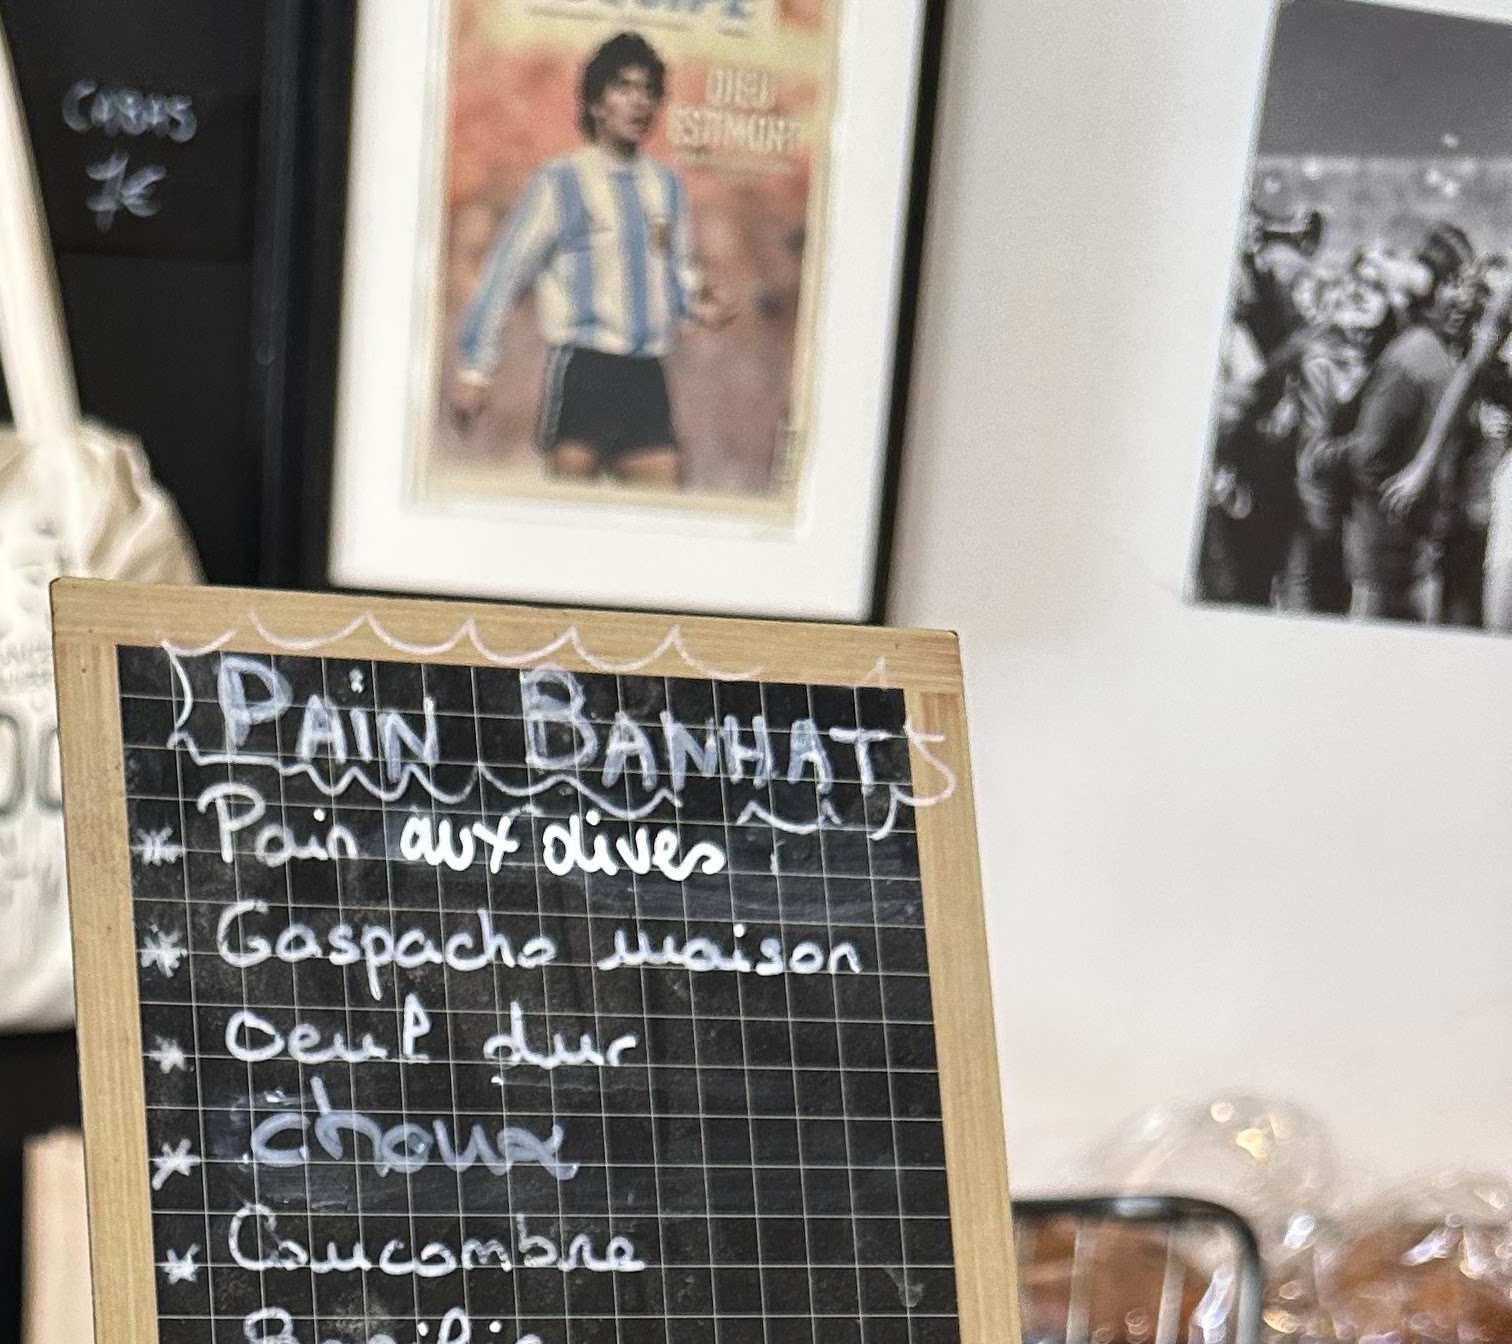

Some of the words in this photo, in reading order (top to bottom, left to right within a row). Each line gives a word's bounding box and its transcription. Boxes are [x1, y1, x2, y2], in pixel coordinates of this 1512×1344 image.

[196, 783, 359, 868] Pain
[399, 814, 522, 875] aux
[216, 898, 558, 1000] Gaspacho
[482, 1000, 640, 1070] dur
